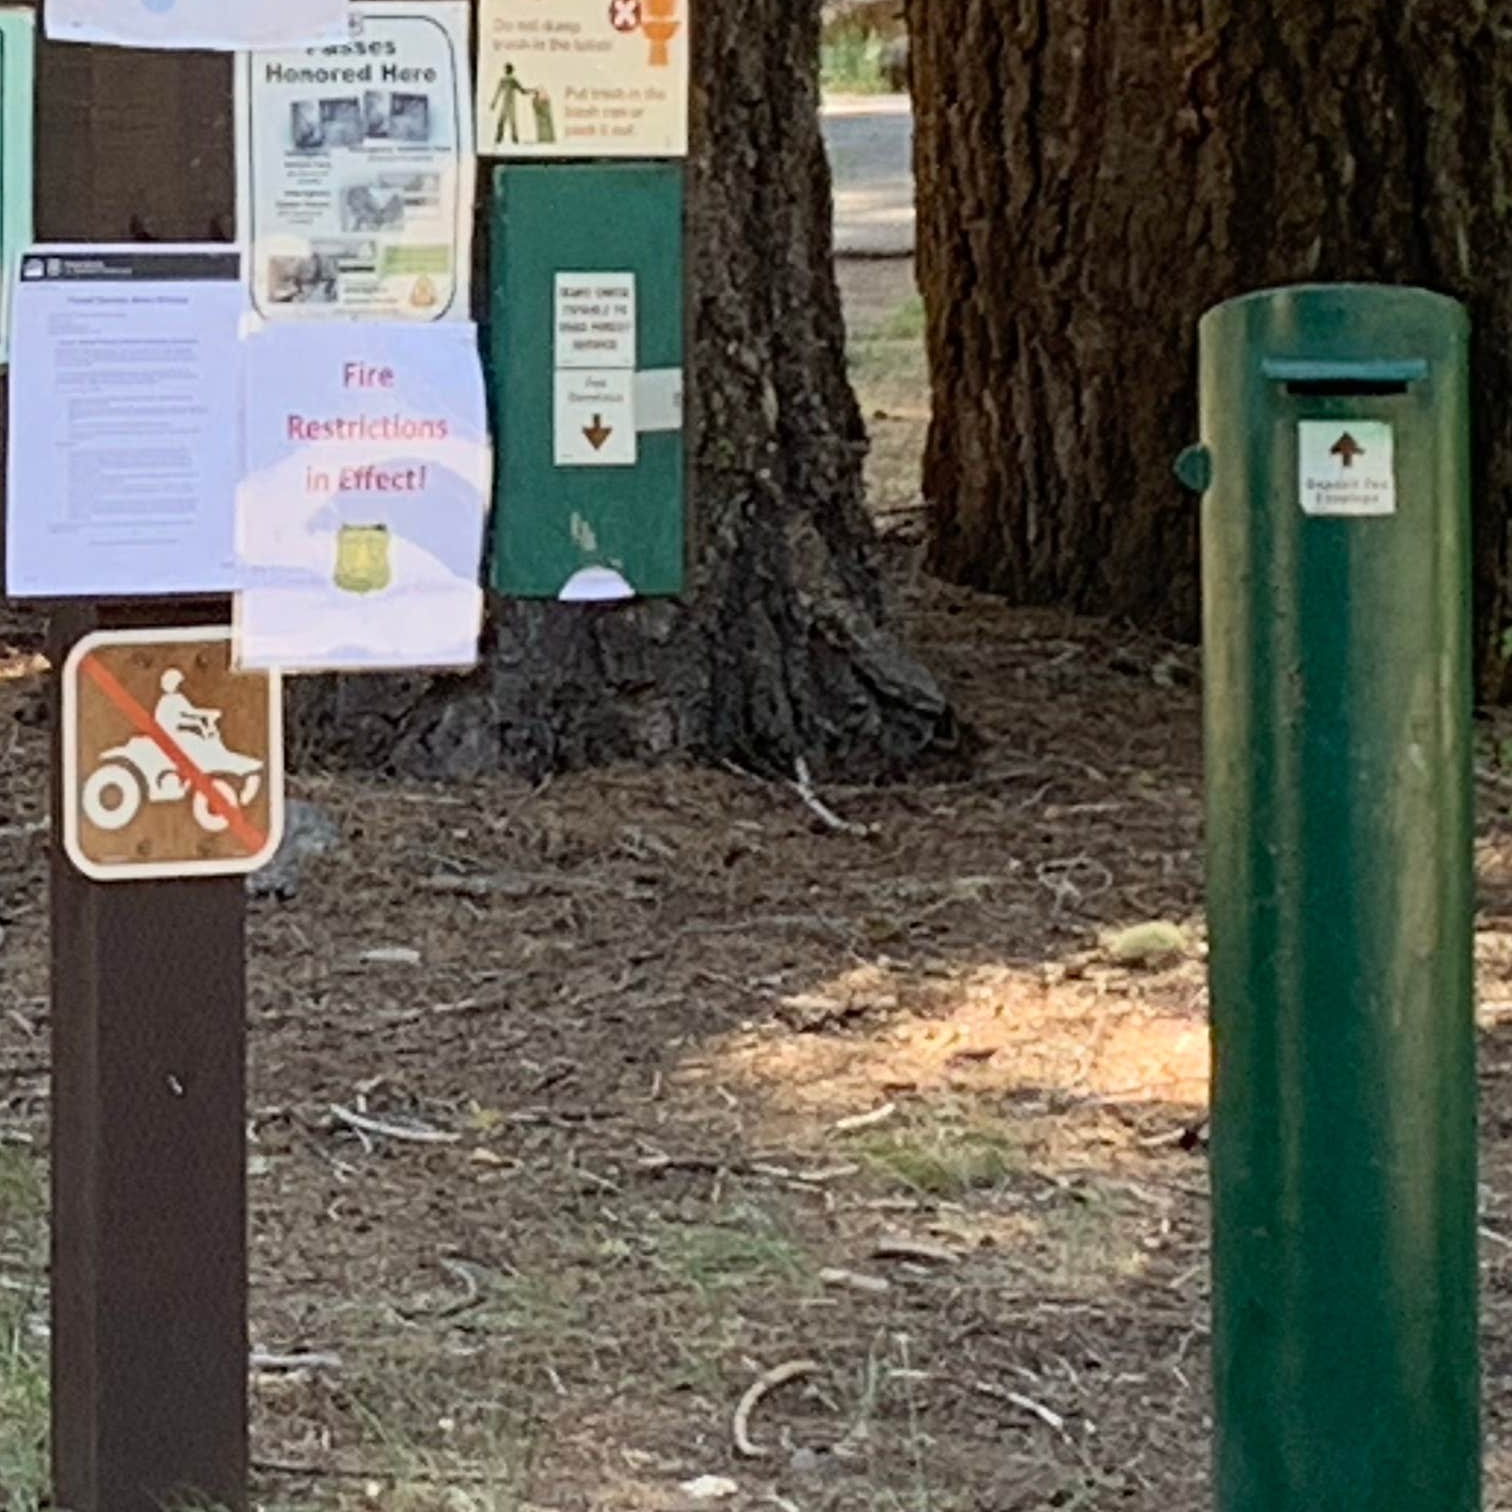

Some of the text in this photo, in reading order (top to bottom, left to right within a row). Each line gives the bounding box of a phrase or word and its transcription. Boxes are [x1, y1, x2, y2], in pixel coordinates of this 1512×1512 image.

[265, 64, 437, 85] Honored Here
[343, 361, 393, 387] Fire
[288, 413, 448, 440] Restrictions
[307, 465, 426, 492] in Effect!
